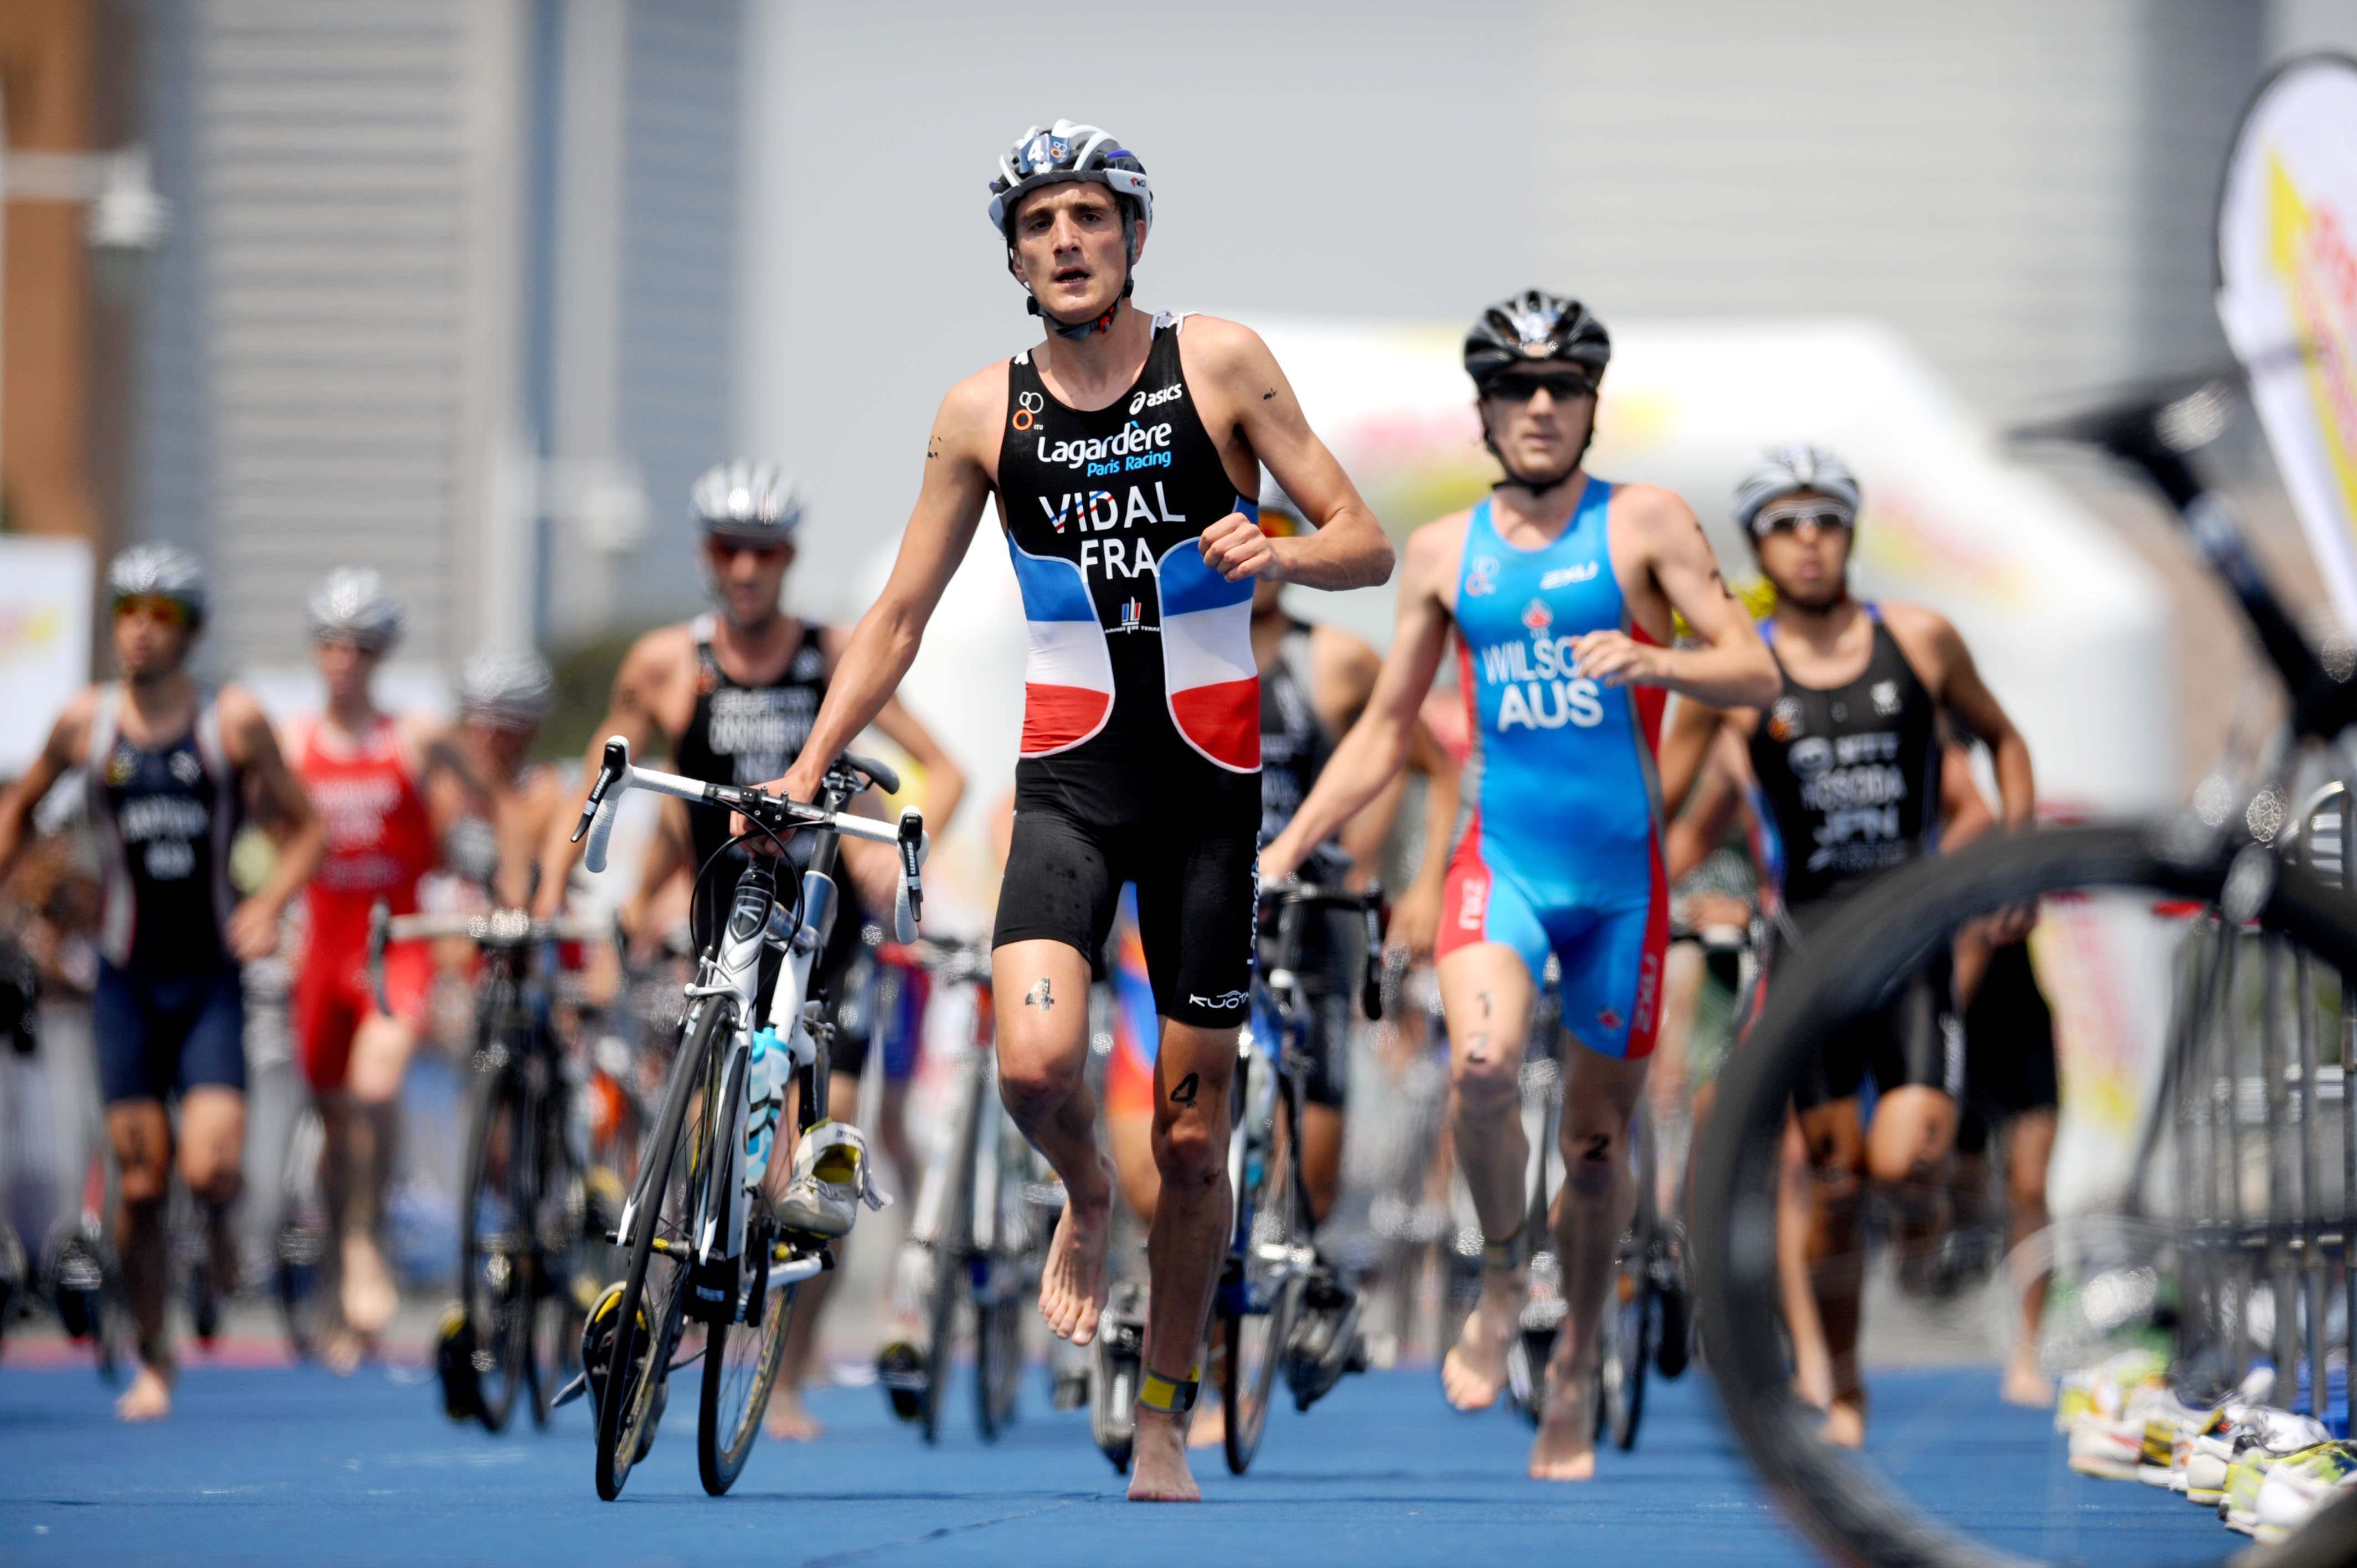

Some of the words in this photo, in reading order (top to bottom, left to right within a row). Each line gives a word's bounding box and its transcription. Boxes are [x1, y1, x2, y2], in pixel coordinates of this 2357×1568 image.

[1027, 138, 1044, 162] 4
[1146, 383, 1182, 407] asics
[1037, 420, 1172, 469] Lagardère
[1087, 459, 1120, 477] Paris
[1125, 451, 1171, 471] Racing
[1038, 481, 1186, 534] VIDAL
[1080, 537, 1161, 583] FRA
[1480, 635, 1583, 686] WILSO
[1496, 678, 1604, 734] AUS
[907, 842, 916, 874] SRAM
[1025, 978, 1054, 1010] 4
[1170, 1072, 1199, 1107] 4
